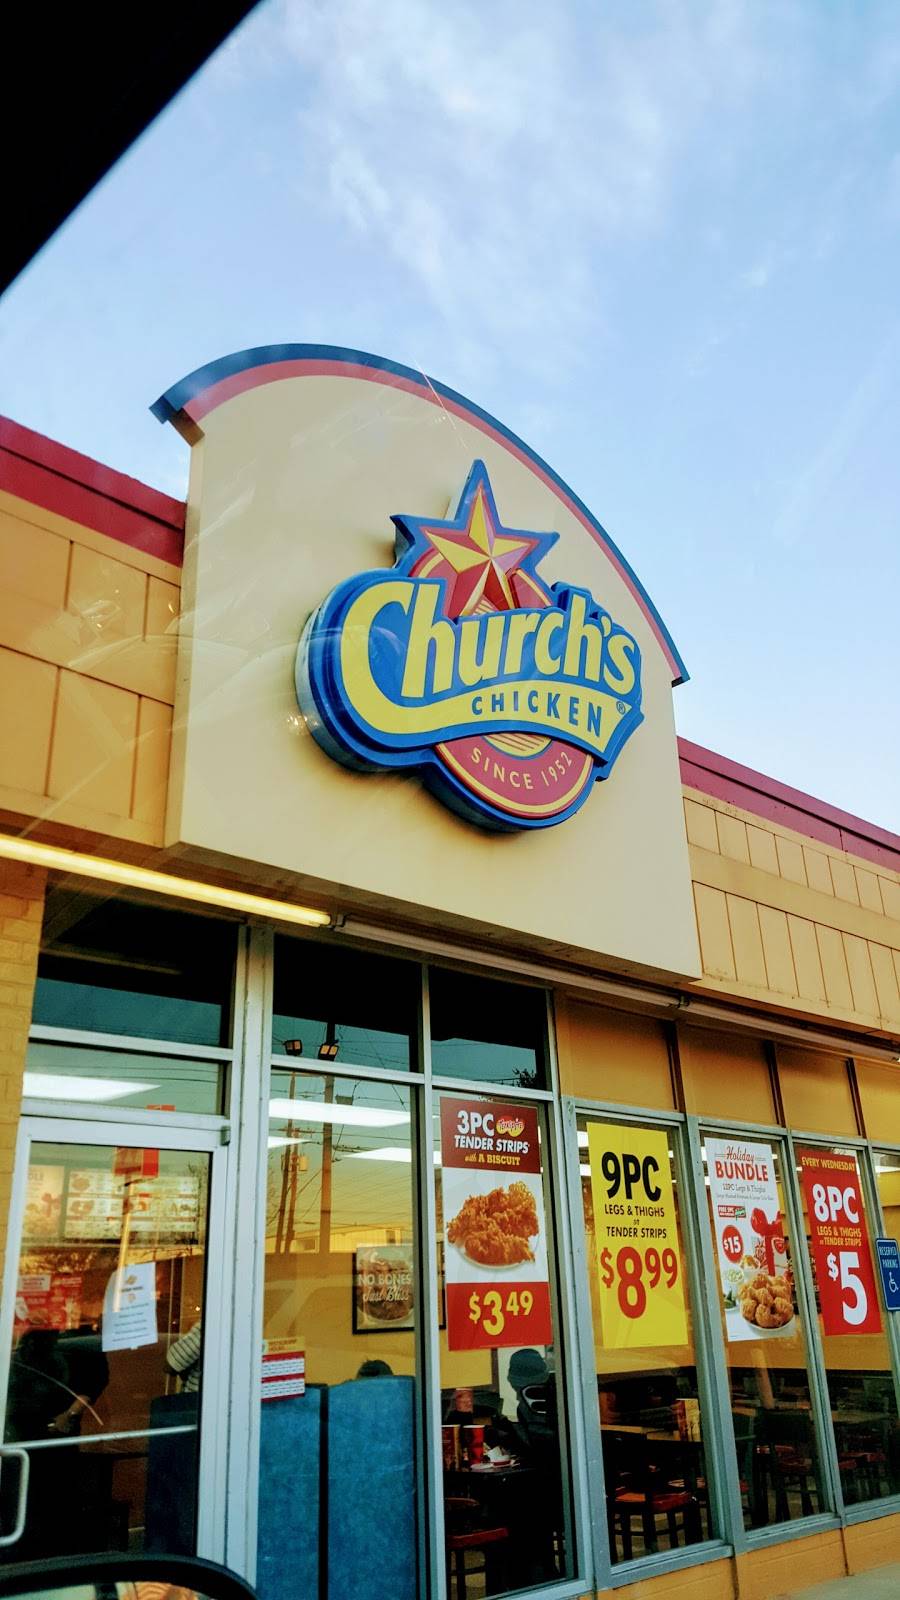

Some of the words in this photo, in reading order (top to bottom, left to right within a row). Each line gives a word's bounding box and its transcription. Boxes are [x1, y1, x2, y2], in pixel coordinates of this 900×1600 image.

[341, 581, 636, 722] Church's
[472, 689, 603, 738] CHICKEN
[471, 747, 534, 790] SINCE
[541, 751, 573, 787] 1952
[457, 1110, 495, 1137] 3PC
[454, 1135, 494, 1151] TENDER
[496, 1139, 529, 1154] STRIPS
[478, 1155, 485, 1163] A
[486, 1155, 521, 1166] BISCUIT
[726, 1145, 755, 1165] Holiday
[801, 1156, 820, 1168] EVERY
[820, 1159, 855, 1172] WEDNESDAY
[601, 1151, 661, 1202] 9PC
[715, 1160, 768, 1182] BUNDLE
[605, 1203, 625, 1216] LEGS
[627, 1206, 633, 1216] &
[634, 1206, 665, 1218] THIGHS
[812, 1183, 860, 1224] 8PC
[606, 1226, 638, 1238] TENDER
[641, 1227, 667, 1239] STRIPS
[816, 1225, 833, 1236] LEGS
[833, 1227, 839, 1236] &
[839, 1227, 862, 1238] THIGHS
[724, 1235, 741, 1254] $15
[824, 1237, 844, 1246] TENDER
[844, 1238, 862, 1247] STRIPS
[357, 1273, 375, 1286] NO
[378, 1272, 411, 1286] BONES
[827, 1251, 868, 1326] $5
